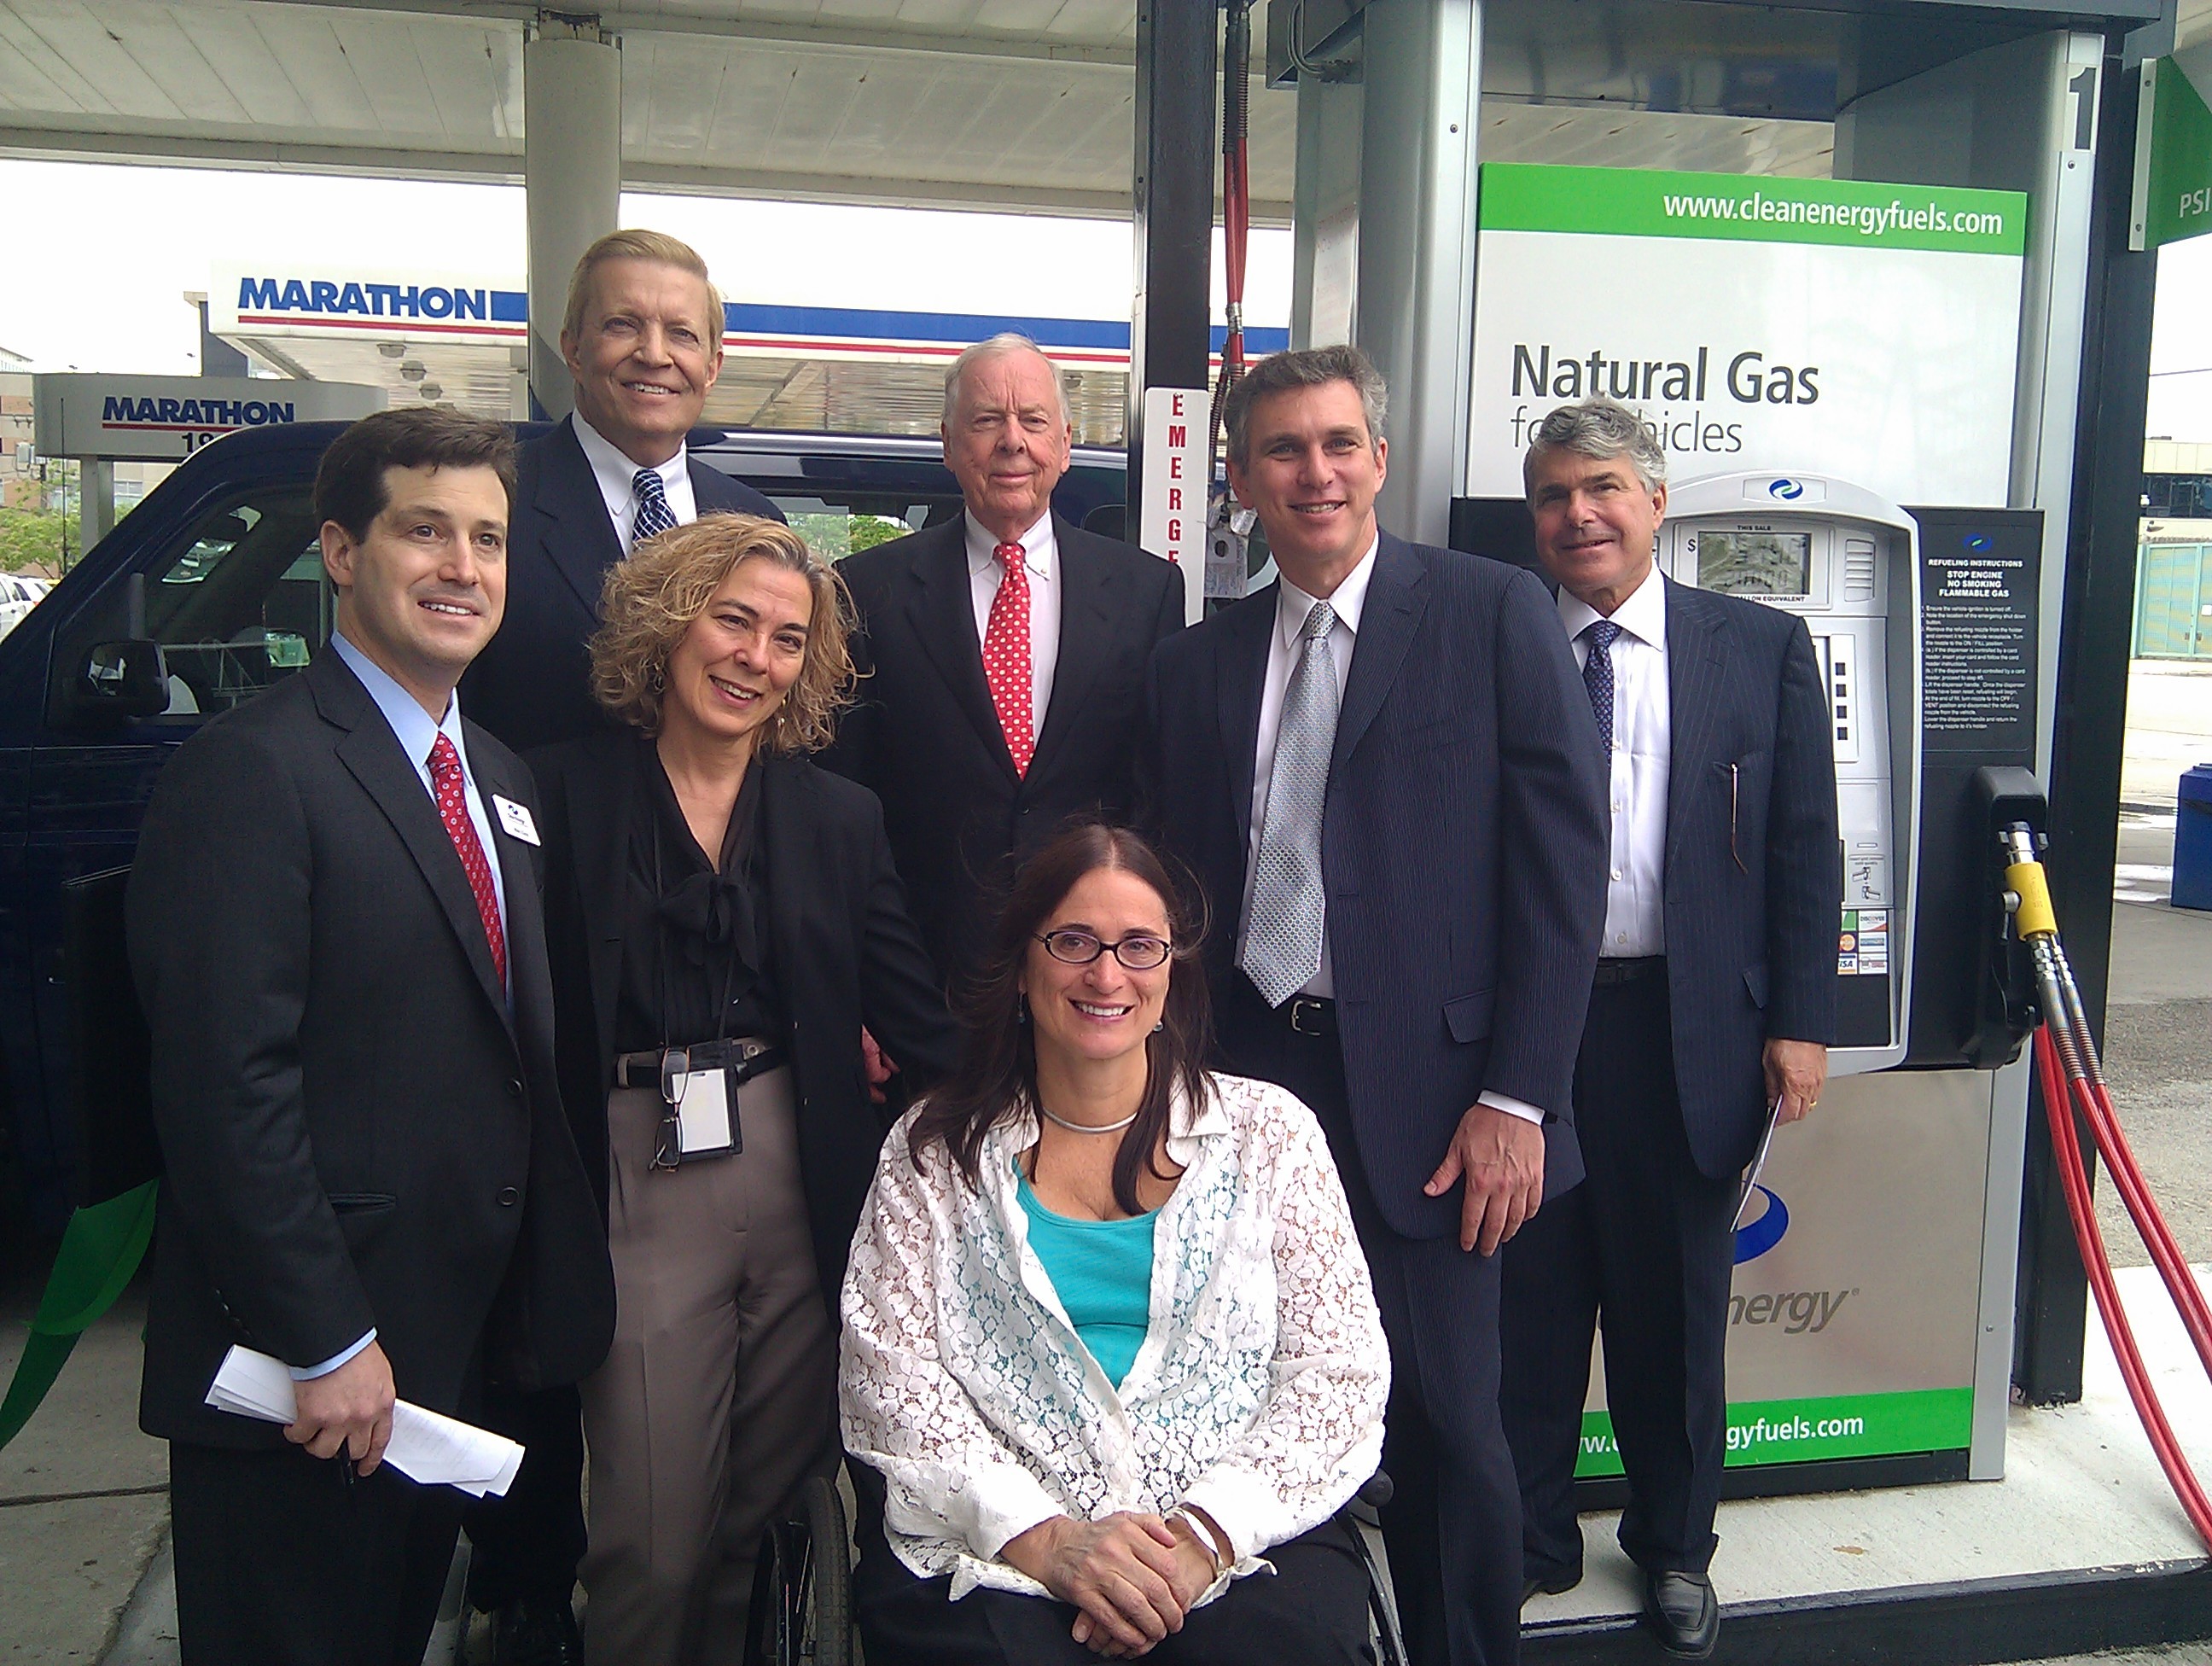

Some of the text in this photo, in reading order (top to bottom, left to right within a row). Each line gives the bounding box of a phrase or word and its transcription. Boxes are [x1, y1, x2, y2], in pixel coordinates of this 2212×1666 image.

[2069, 67, 2097, 149] 1
[1663, 192, 2003, 235] www.cleanenergyfuels.com
[237, 277, 486, 321] MARATHON
[1511, 344, 1819, 405] Natural Gas
[102, 396, 294, 425] MARATHON
[1168, 393, 1186, 563] EMERGE
[1947, 570, 2003, 580] STOP ENGINE
[1970, 559, 2023, 568] INSTRUCTIONS
[1939, 589, 2010, 597] FLAMMABLE GAS
[1963, 580, 2002, 588] SMOKING
[1729, 1290, 1850, 1334] nergy
[1726, 1415, 1864, 1450] gyfuels.com
